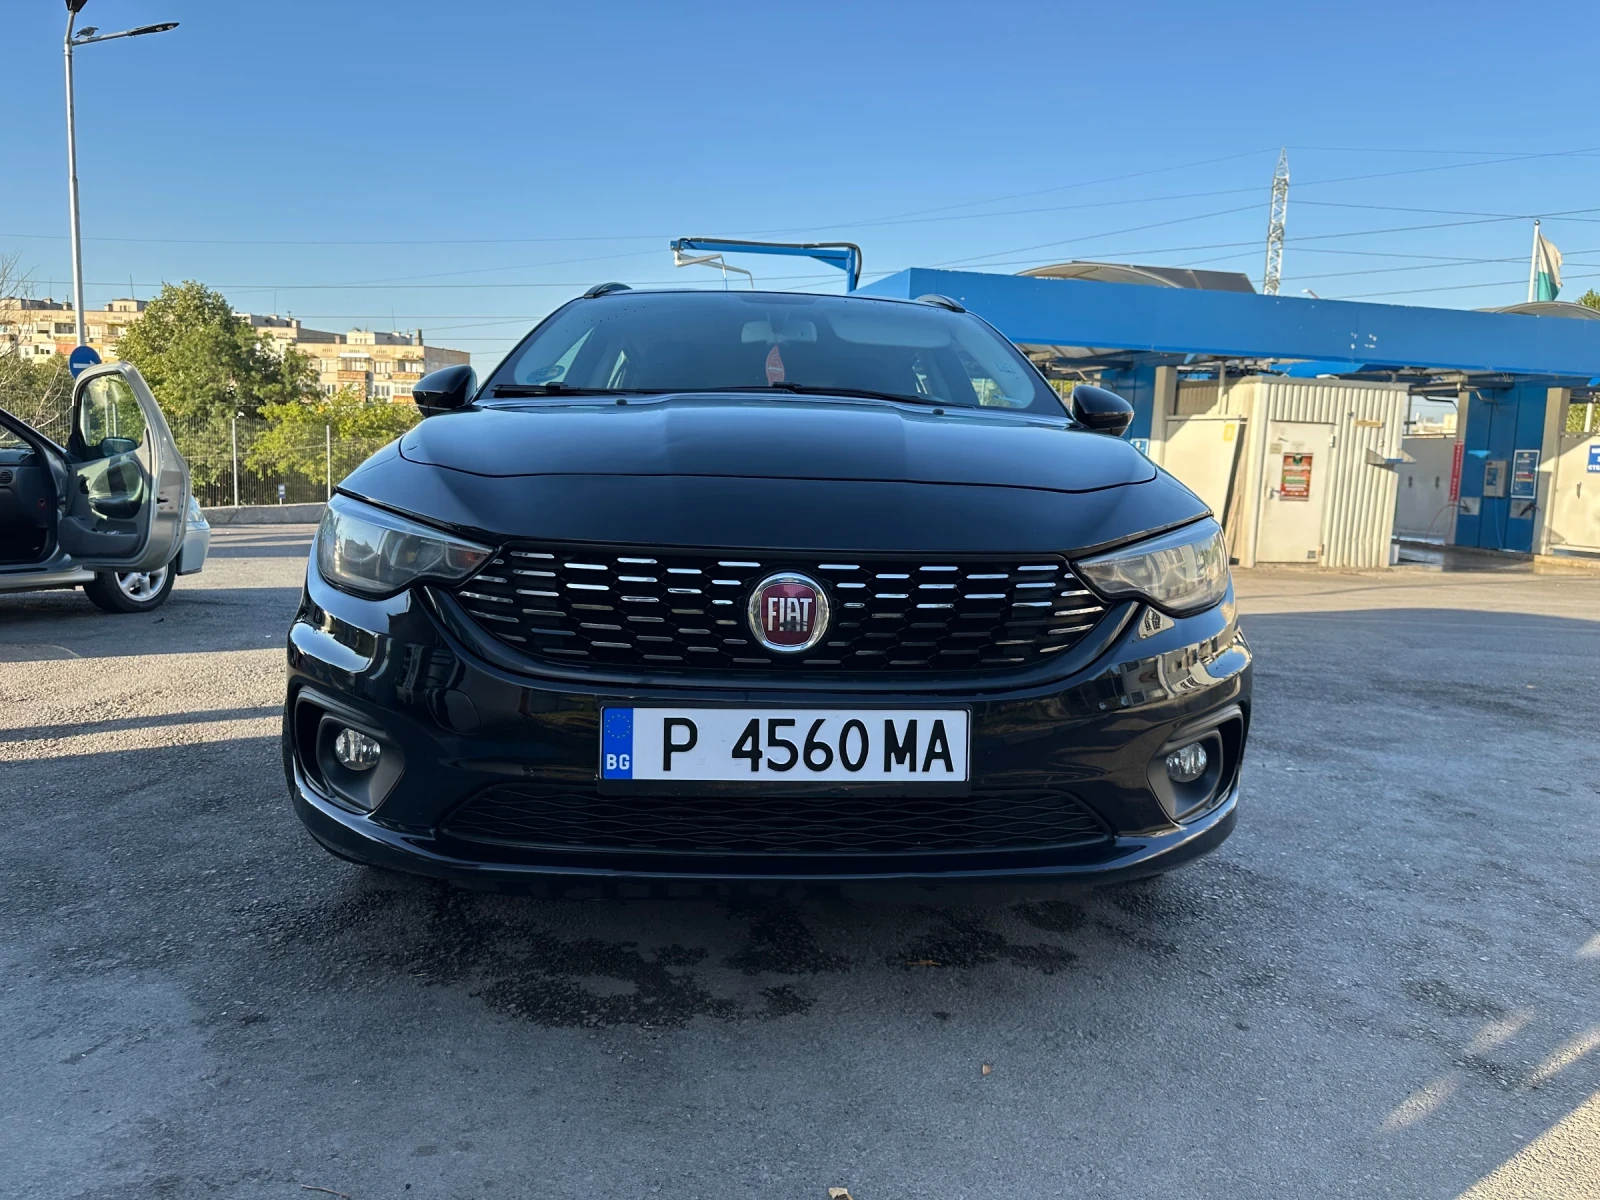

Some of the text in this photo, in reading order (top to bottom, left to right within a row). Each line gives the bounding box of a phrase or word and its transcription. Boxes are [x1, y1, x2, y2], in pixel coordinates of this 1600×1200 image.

[767, 597, 813, 632] FIAT
[606, 754, 631, 770] BG
[663, 717, 955, 773] P 4560 MA
